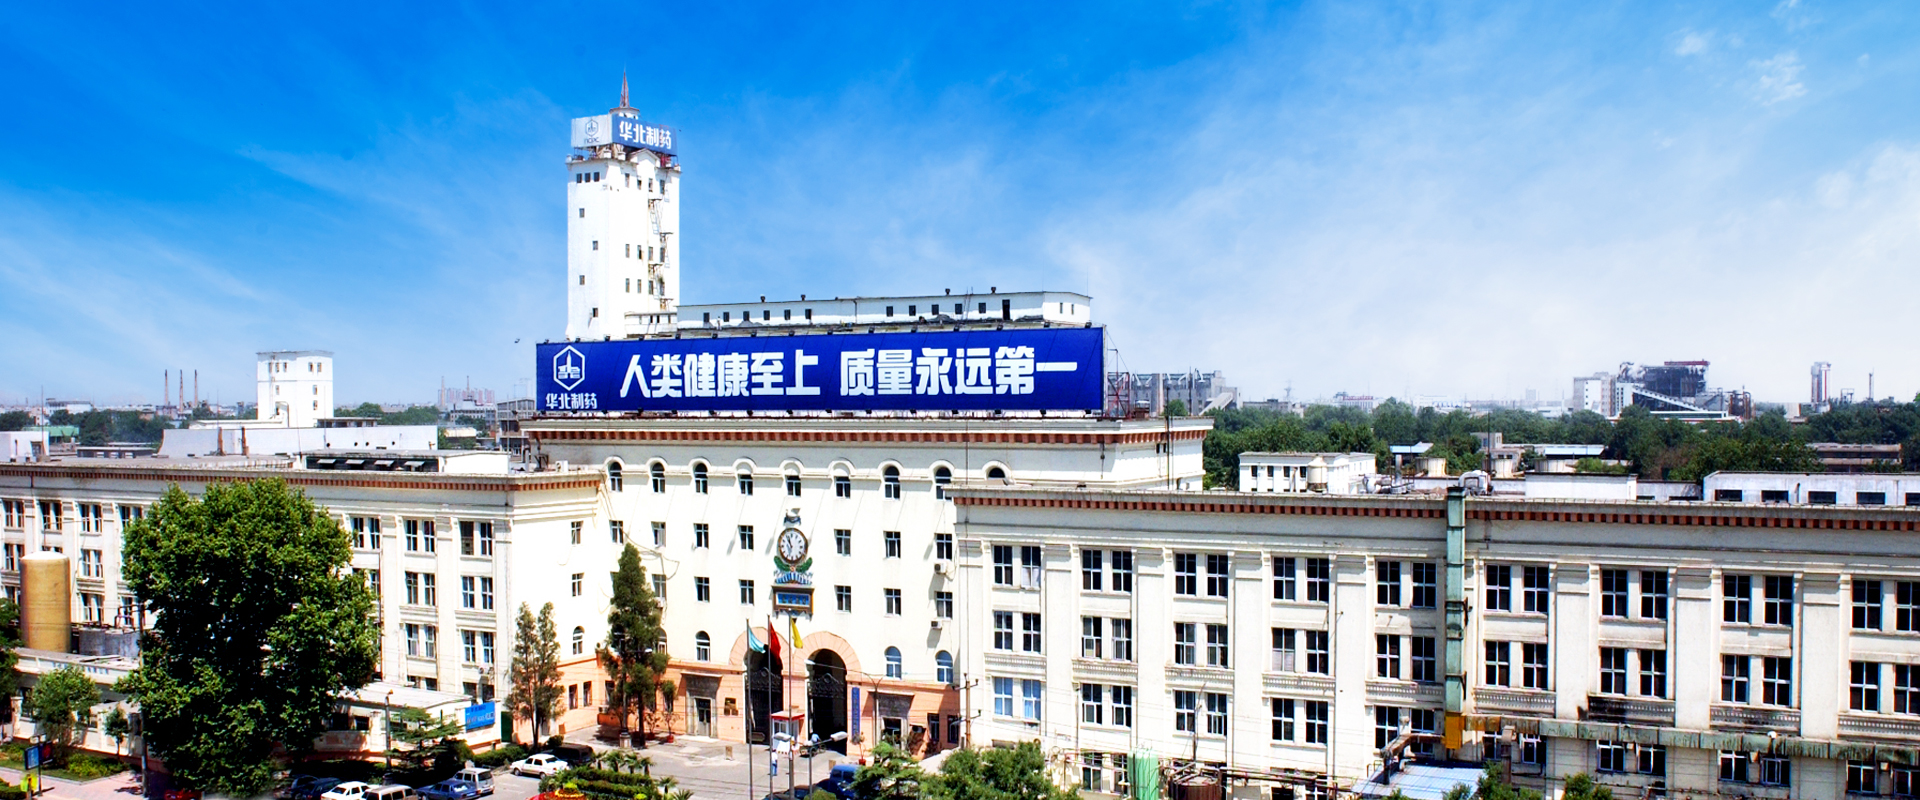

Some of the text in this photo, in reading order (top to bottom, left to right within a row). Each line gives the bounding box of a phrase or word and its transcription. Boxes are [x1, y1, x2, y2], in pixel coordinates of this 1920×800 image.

[619, 120, 671, 149] 华北制药
[620, 345, 1078, 398] 人类健康至上 质量永远第一
[545, 392, 598, 410] 华北制药
